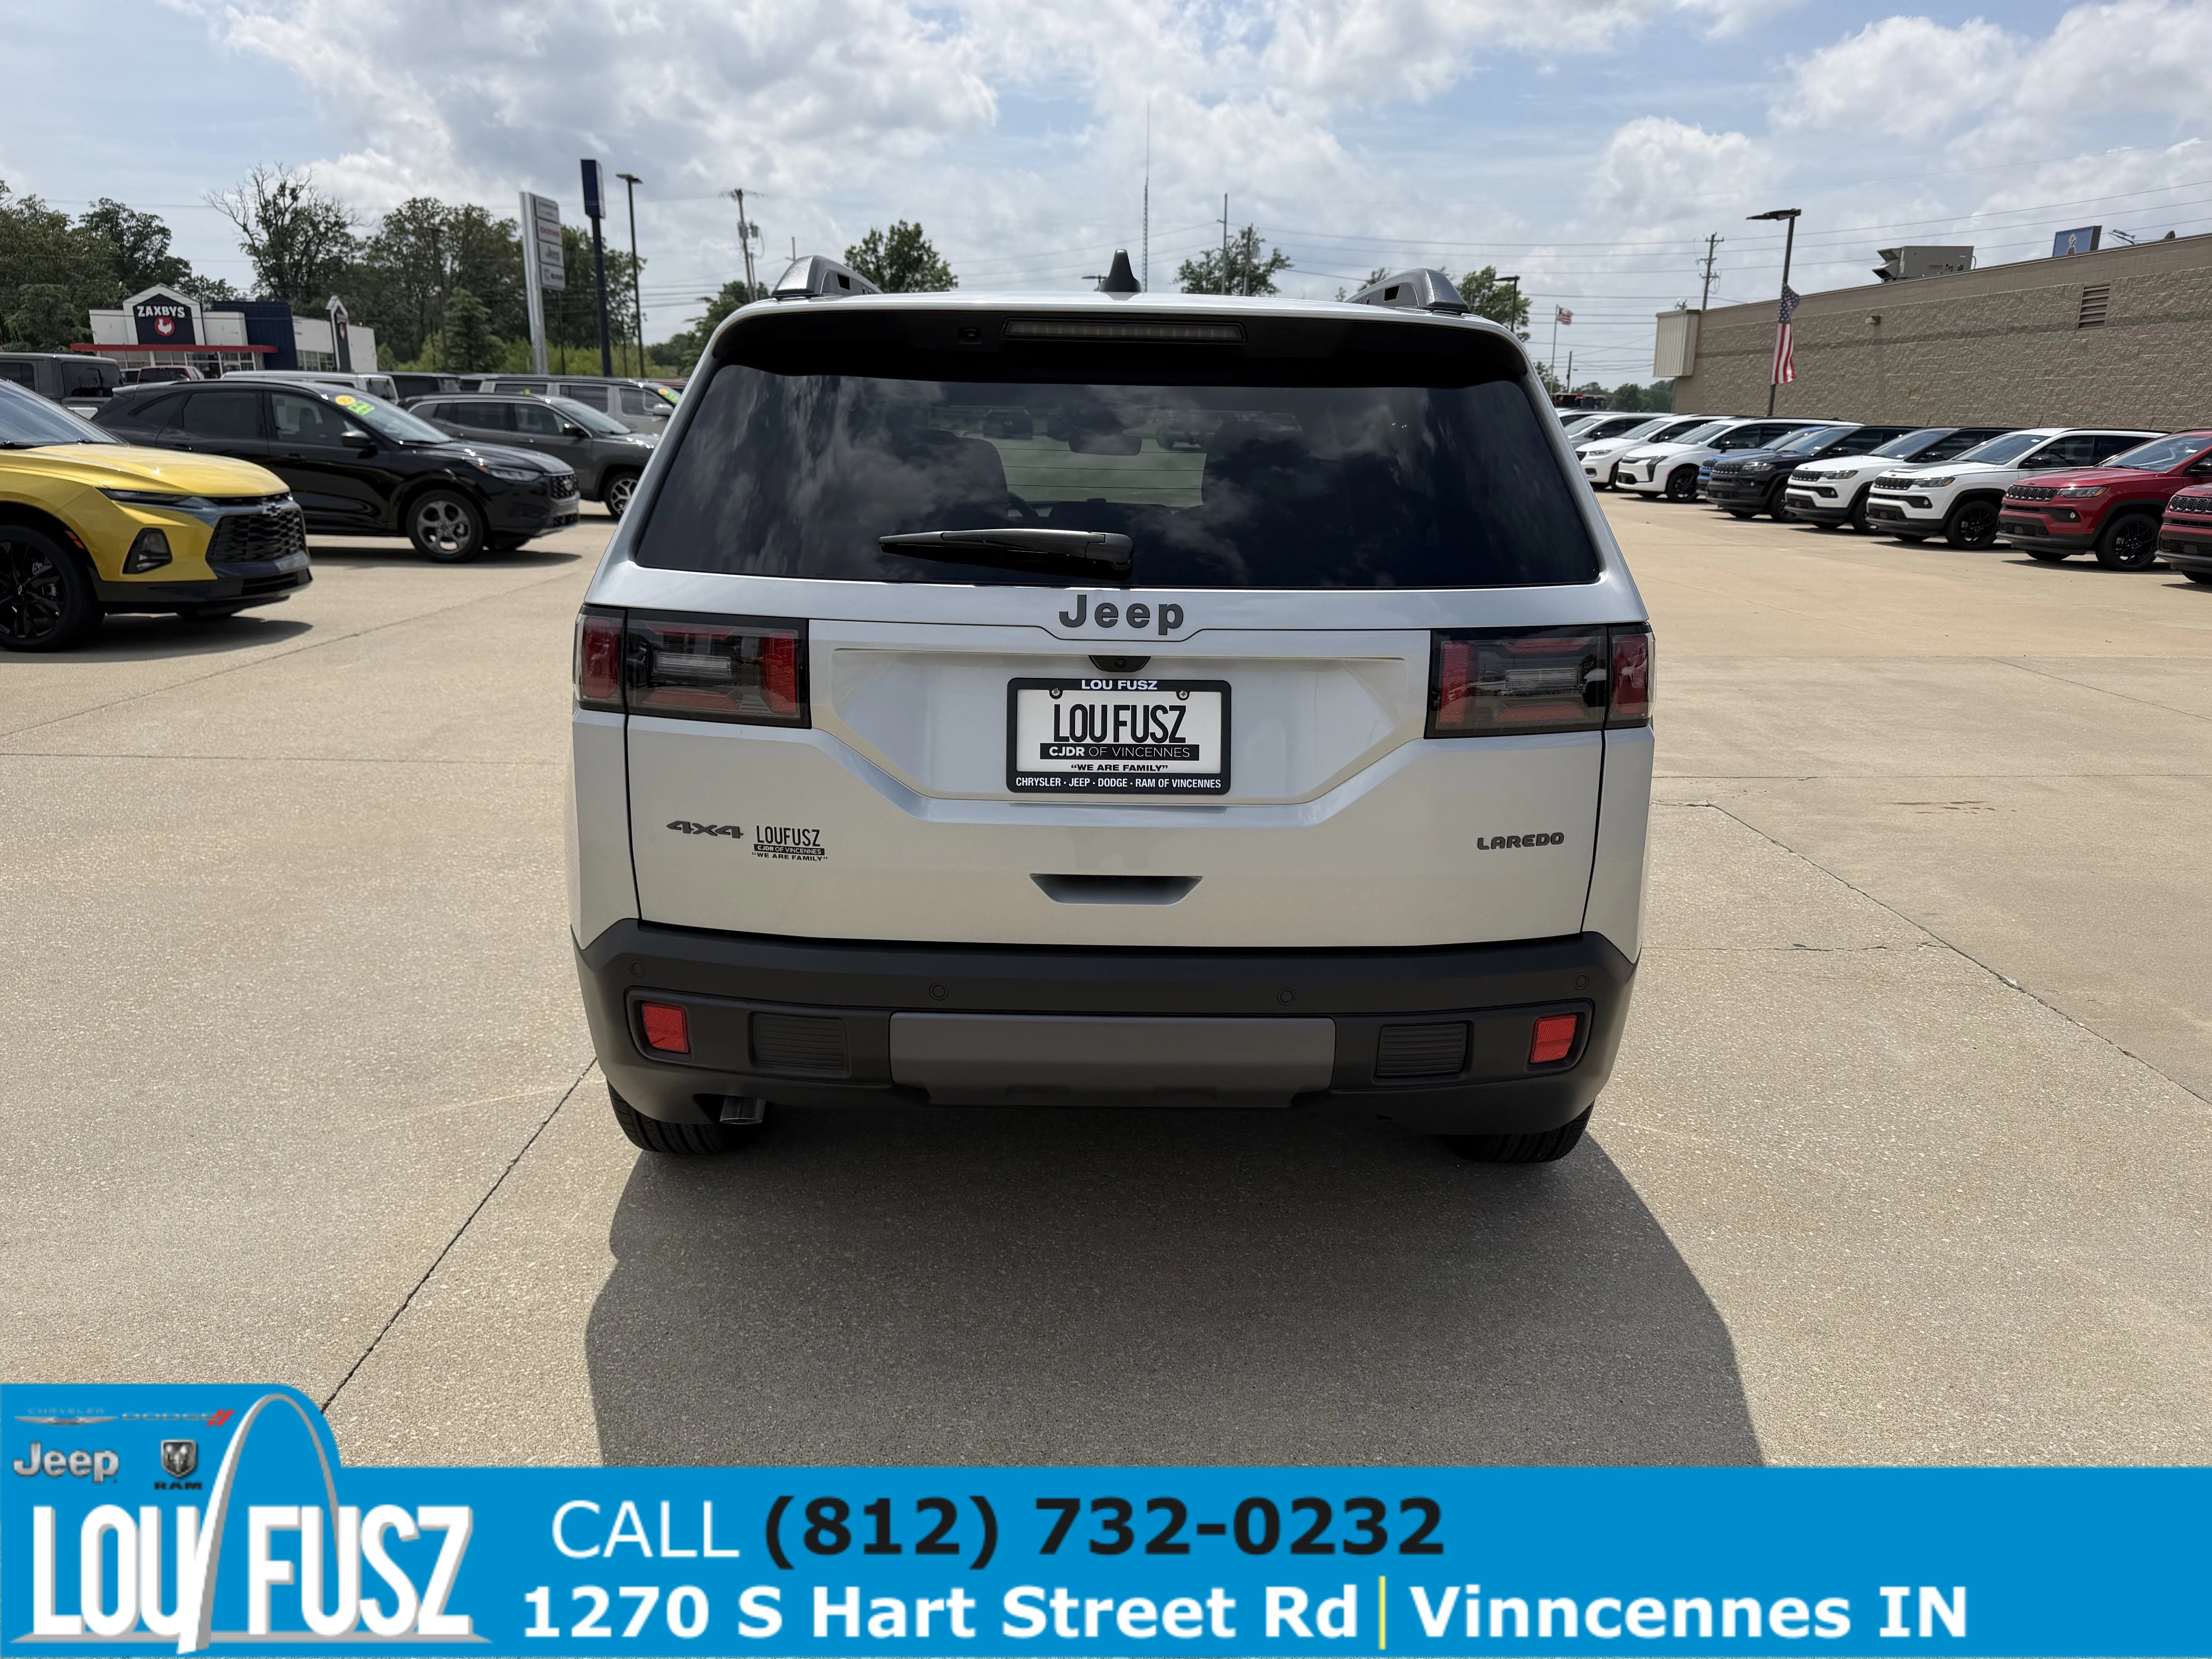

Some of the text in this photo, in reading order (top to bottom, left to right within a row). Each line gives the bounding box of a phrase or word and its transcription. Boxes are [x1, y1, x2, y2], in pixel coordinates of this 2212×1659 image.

[137, 306, 185, 318] ZAXBYS
[1059, 594, 1183, 635] Jeep
[1082, 680, 1158, 690] LOU FUSZ
[1054, 704, 1187, 743] LOU FUSZ
[1049, 747, 1190, 757] CJDR OF VINCENNES
[1016, 777, 1221, 788] CHRYSLER JEEP DODGE RAM OF VINCENNES
[1477, 832, 1565, 850] LAREDO
